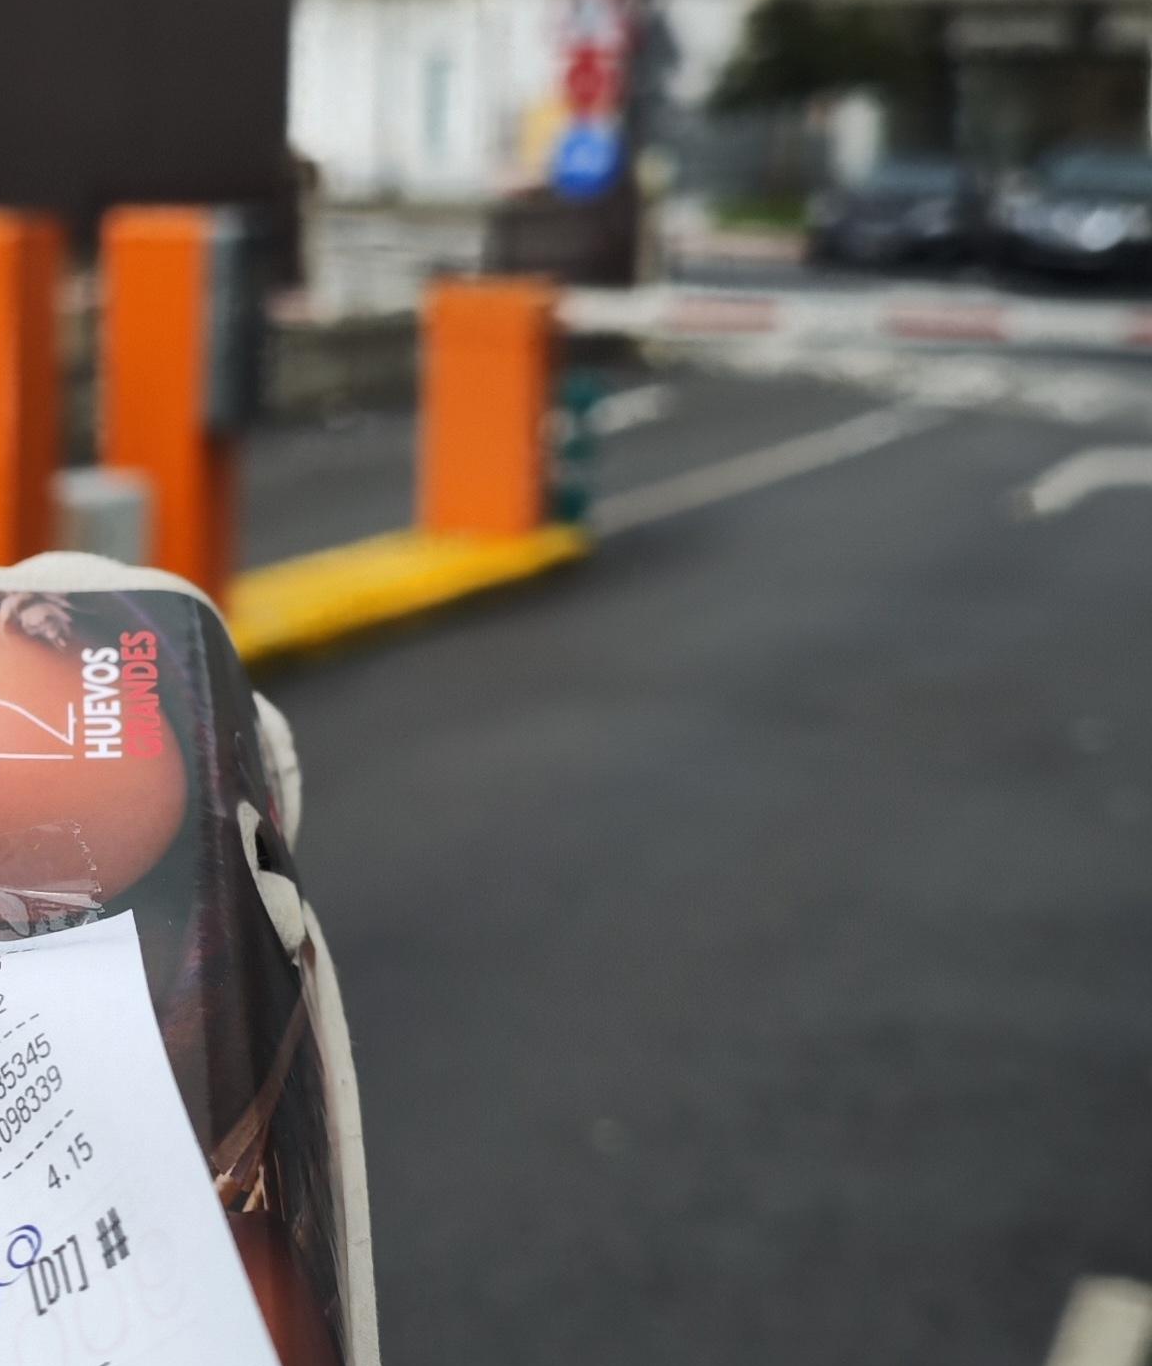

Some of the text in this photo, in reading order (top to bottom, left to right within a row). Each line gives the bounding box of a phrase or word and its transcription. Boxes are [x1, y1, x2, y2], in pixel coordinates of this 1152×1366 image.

[80, 646, 123, 759] HUEVOS
[119, 629, 163, 760] GRANDES
[47, 1133, 95, 1192] 4.15
